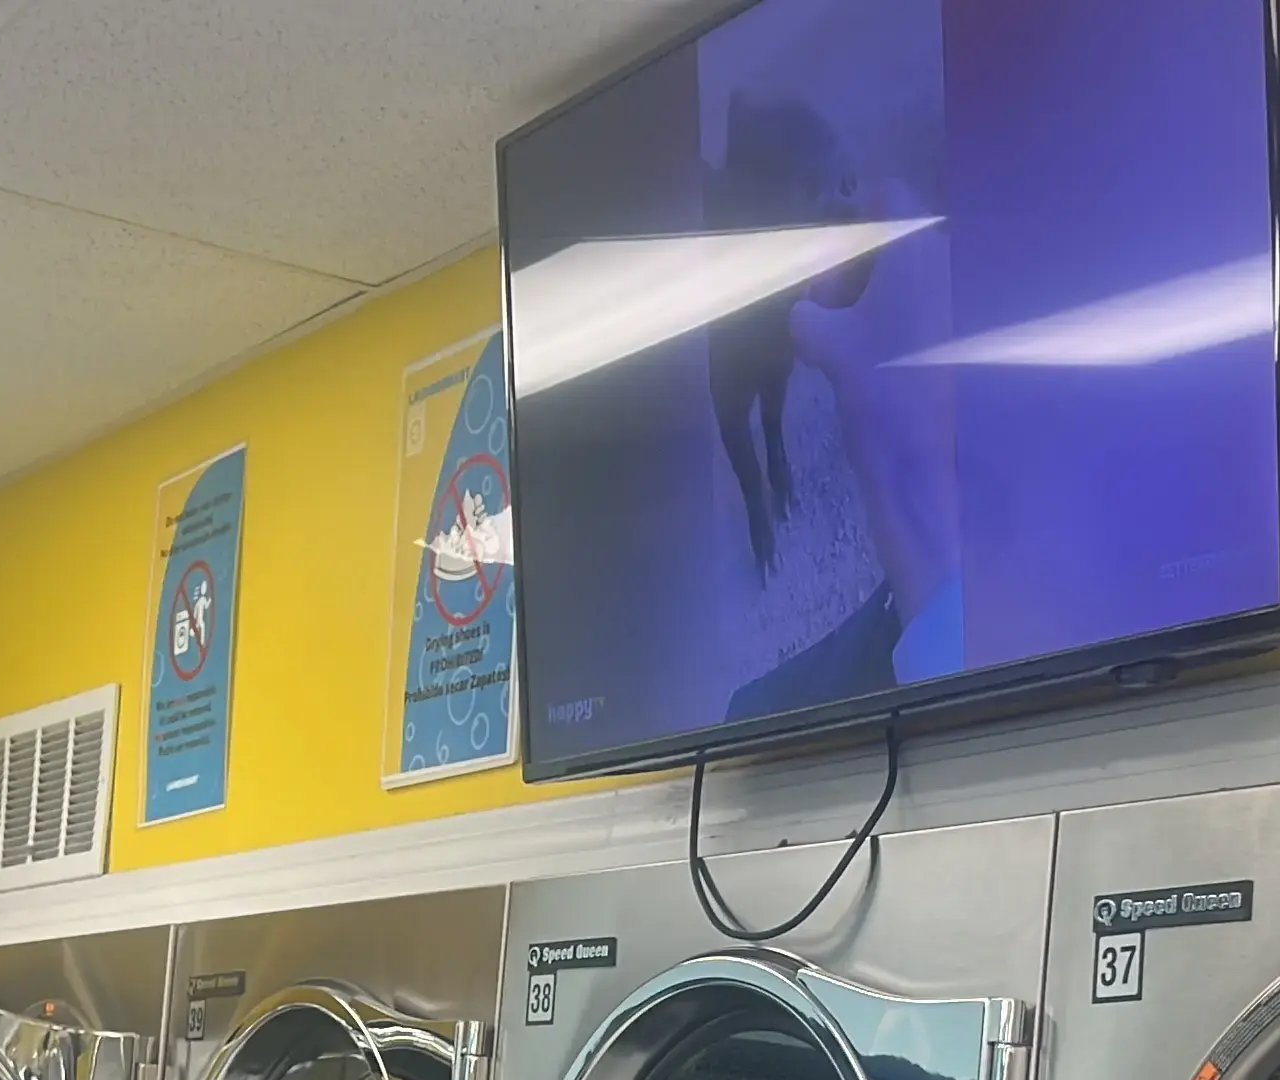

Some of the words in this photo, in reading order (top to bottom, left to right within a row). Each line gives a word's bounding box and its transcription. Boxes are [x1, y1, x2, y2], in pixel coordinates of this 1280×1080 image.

[548, 698, 592, 724] happy
[1120, 894, 1177, 921] Speed
[1182, 892, 1242, 912] Queen
[542, 947, 574, 964] Speed
[576, 944, 609, 959] Queen
[1101, 945, 1136, 986] 37
[531, 983, 551, 1013] 38
